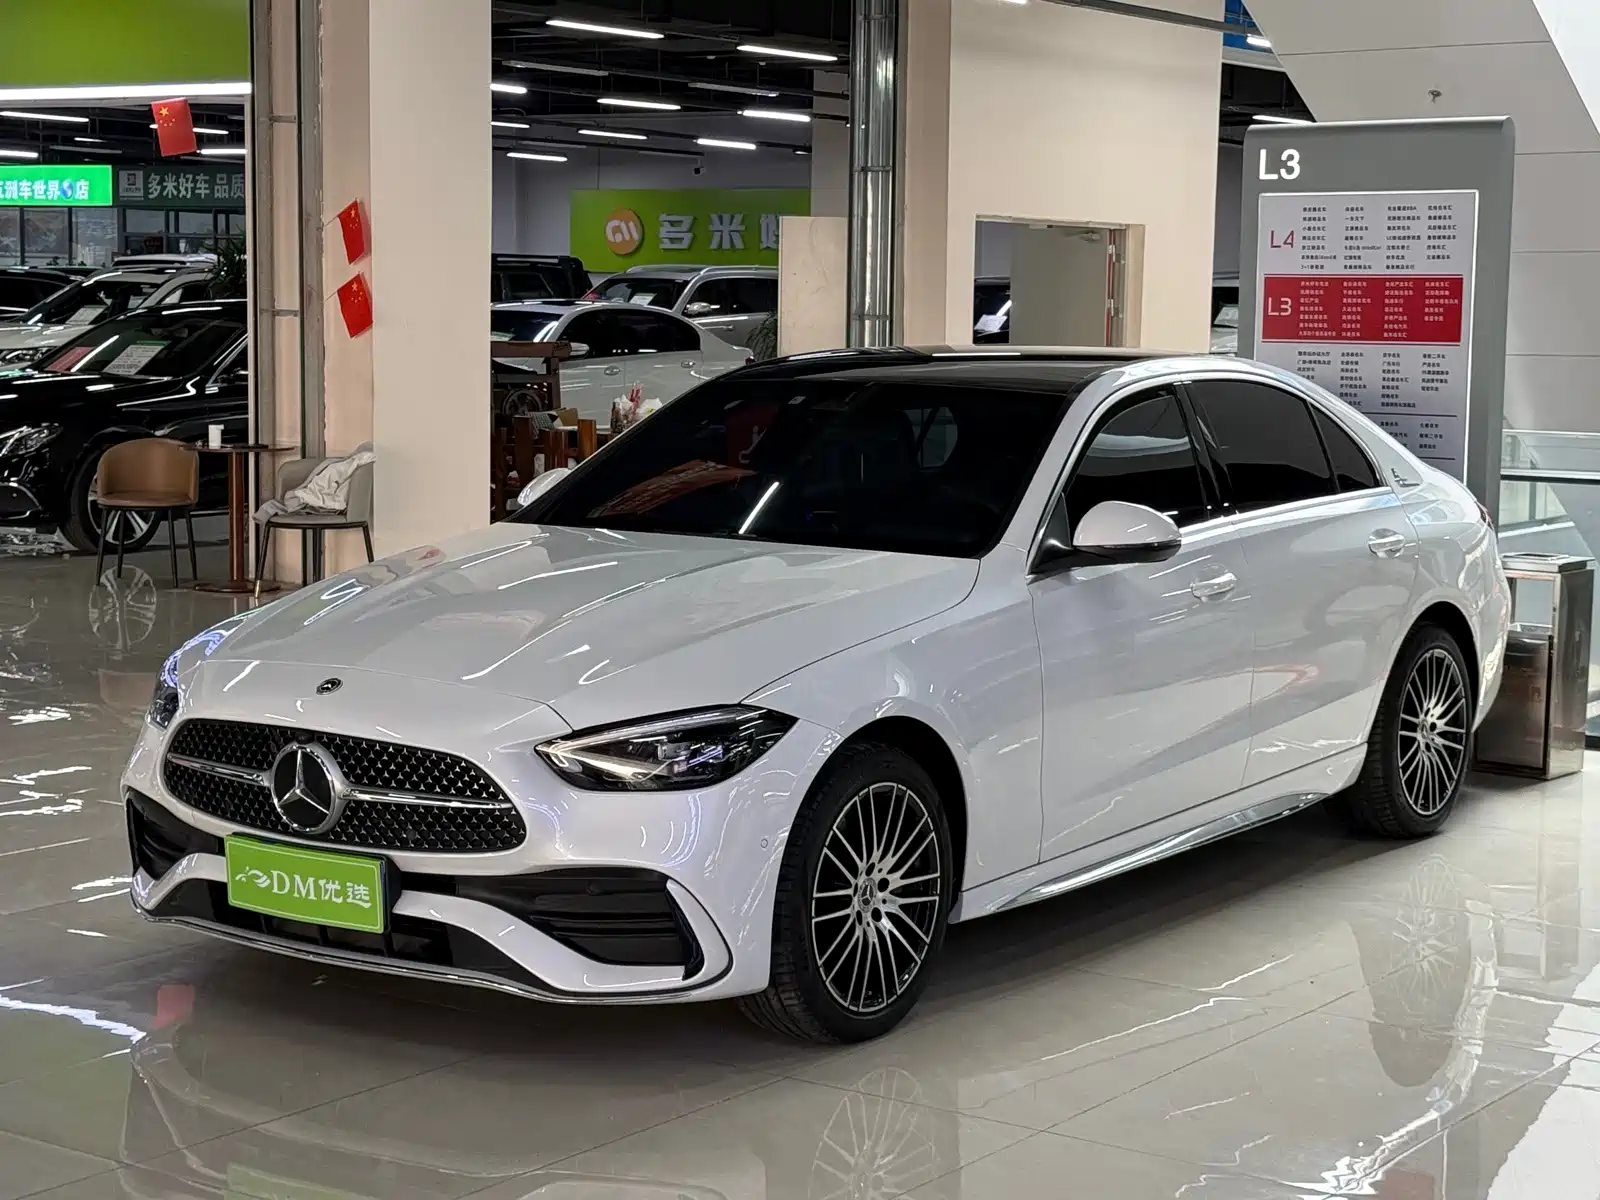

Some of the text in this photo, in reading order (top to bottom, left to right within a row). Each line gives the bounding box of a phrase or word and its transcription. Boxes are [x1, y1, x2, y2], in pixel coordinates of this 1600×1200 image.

[1259, 149, 1301, 180] L3
[147, 173, 210, 199] 多米好车
[1270, 230, 1295, 249] L4
[1267, 297, 1292, 316] L3
